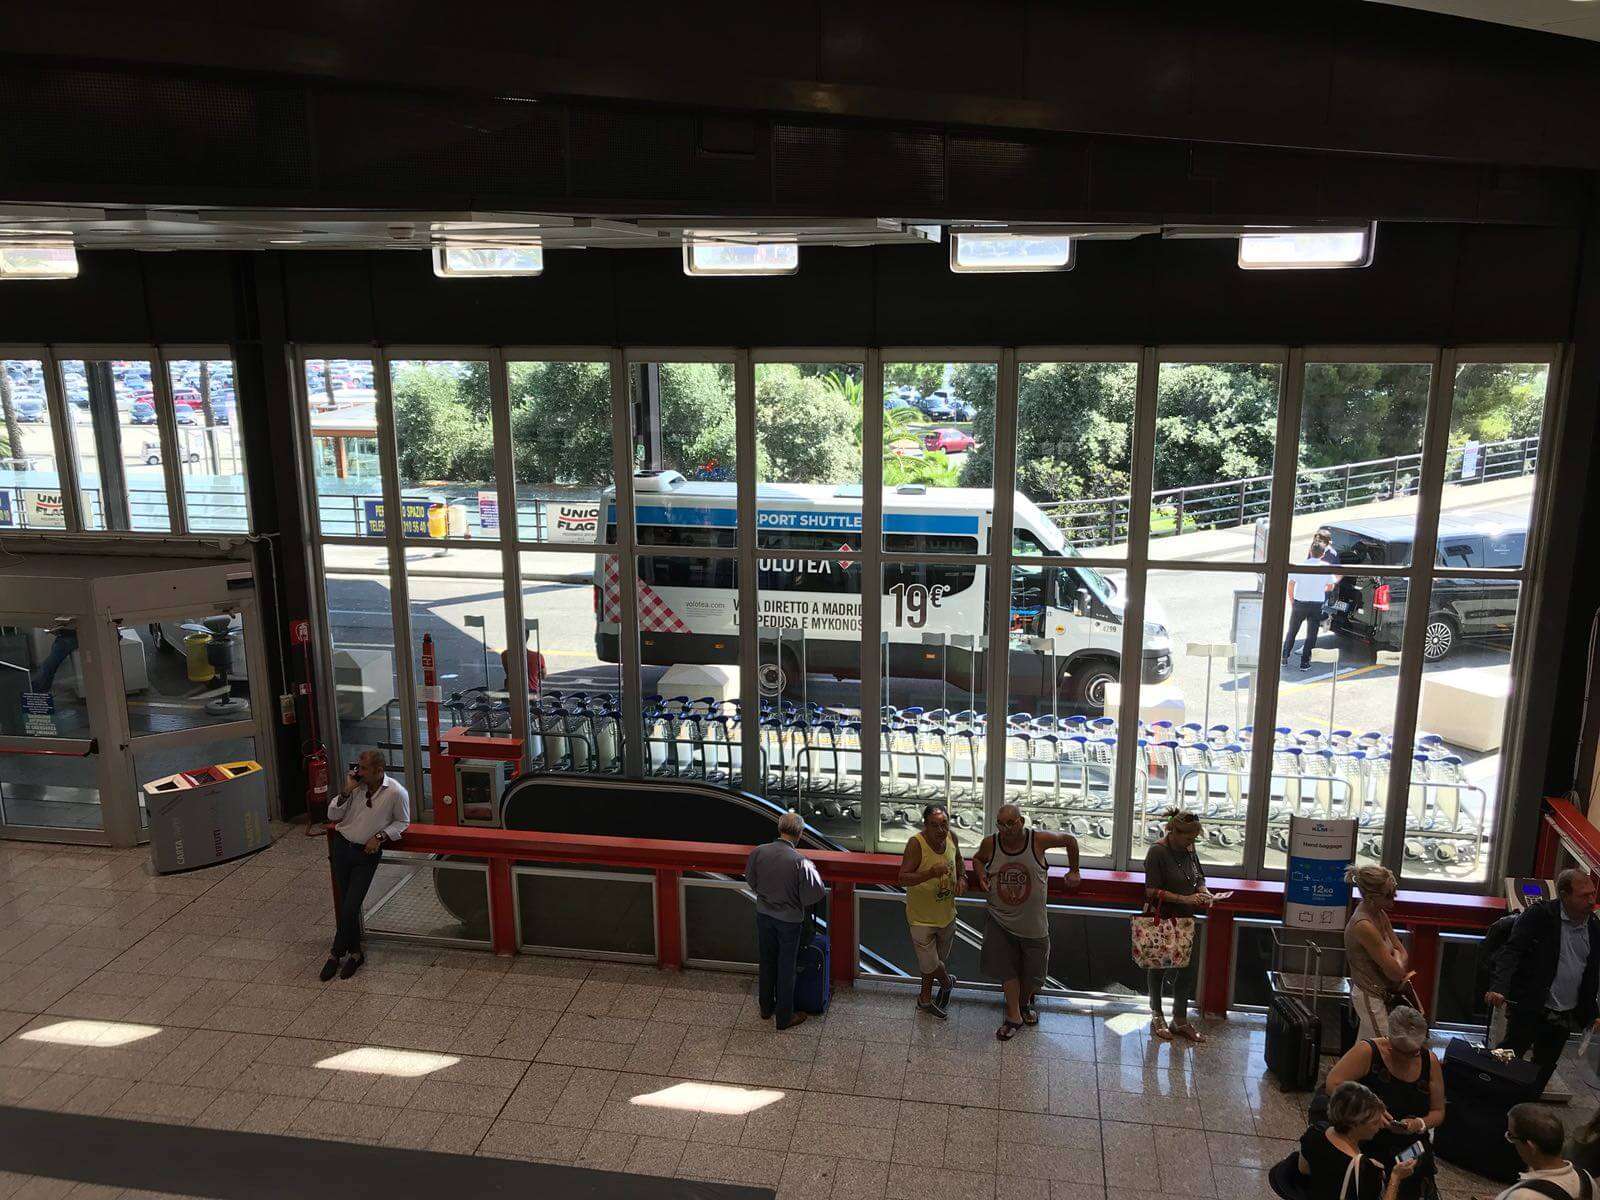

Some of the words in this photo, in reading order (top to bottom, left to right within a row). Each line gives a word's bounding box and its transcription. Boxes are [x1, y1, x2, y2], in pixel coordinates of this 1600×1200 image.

[37, 494, 63, 503] UNI
[560, 507, 599, 518] UNIO
[557, 520, 596, 531] FLAG
[799, 515, 862, 528] SHUTTLE
[764, 600, 808, 614] DIRETTO
[812, 602, 819, 615] A
[734, 614, 799, 630] LPEDUSA
[802, 616, 809, 630] E
[811, 617, 864, 632] MYKONOS
